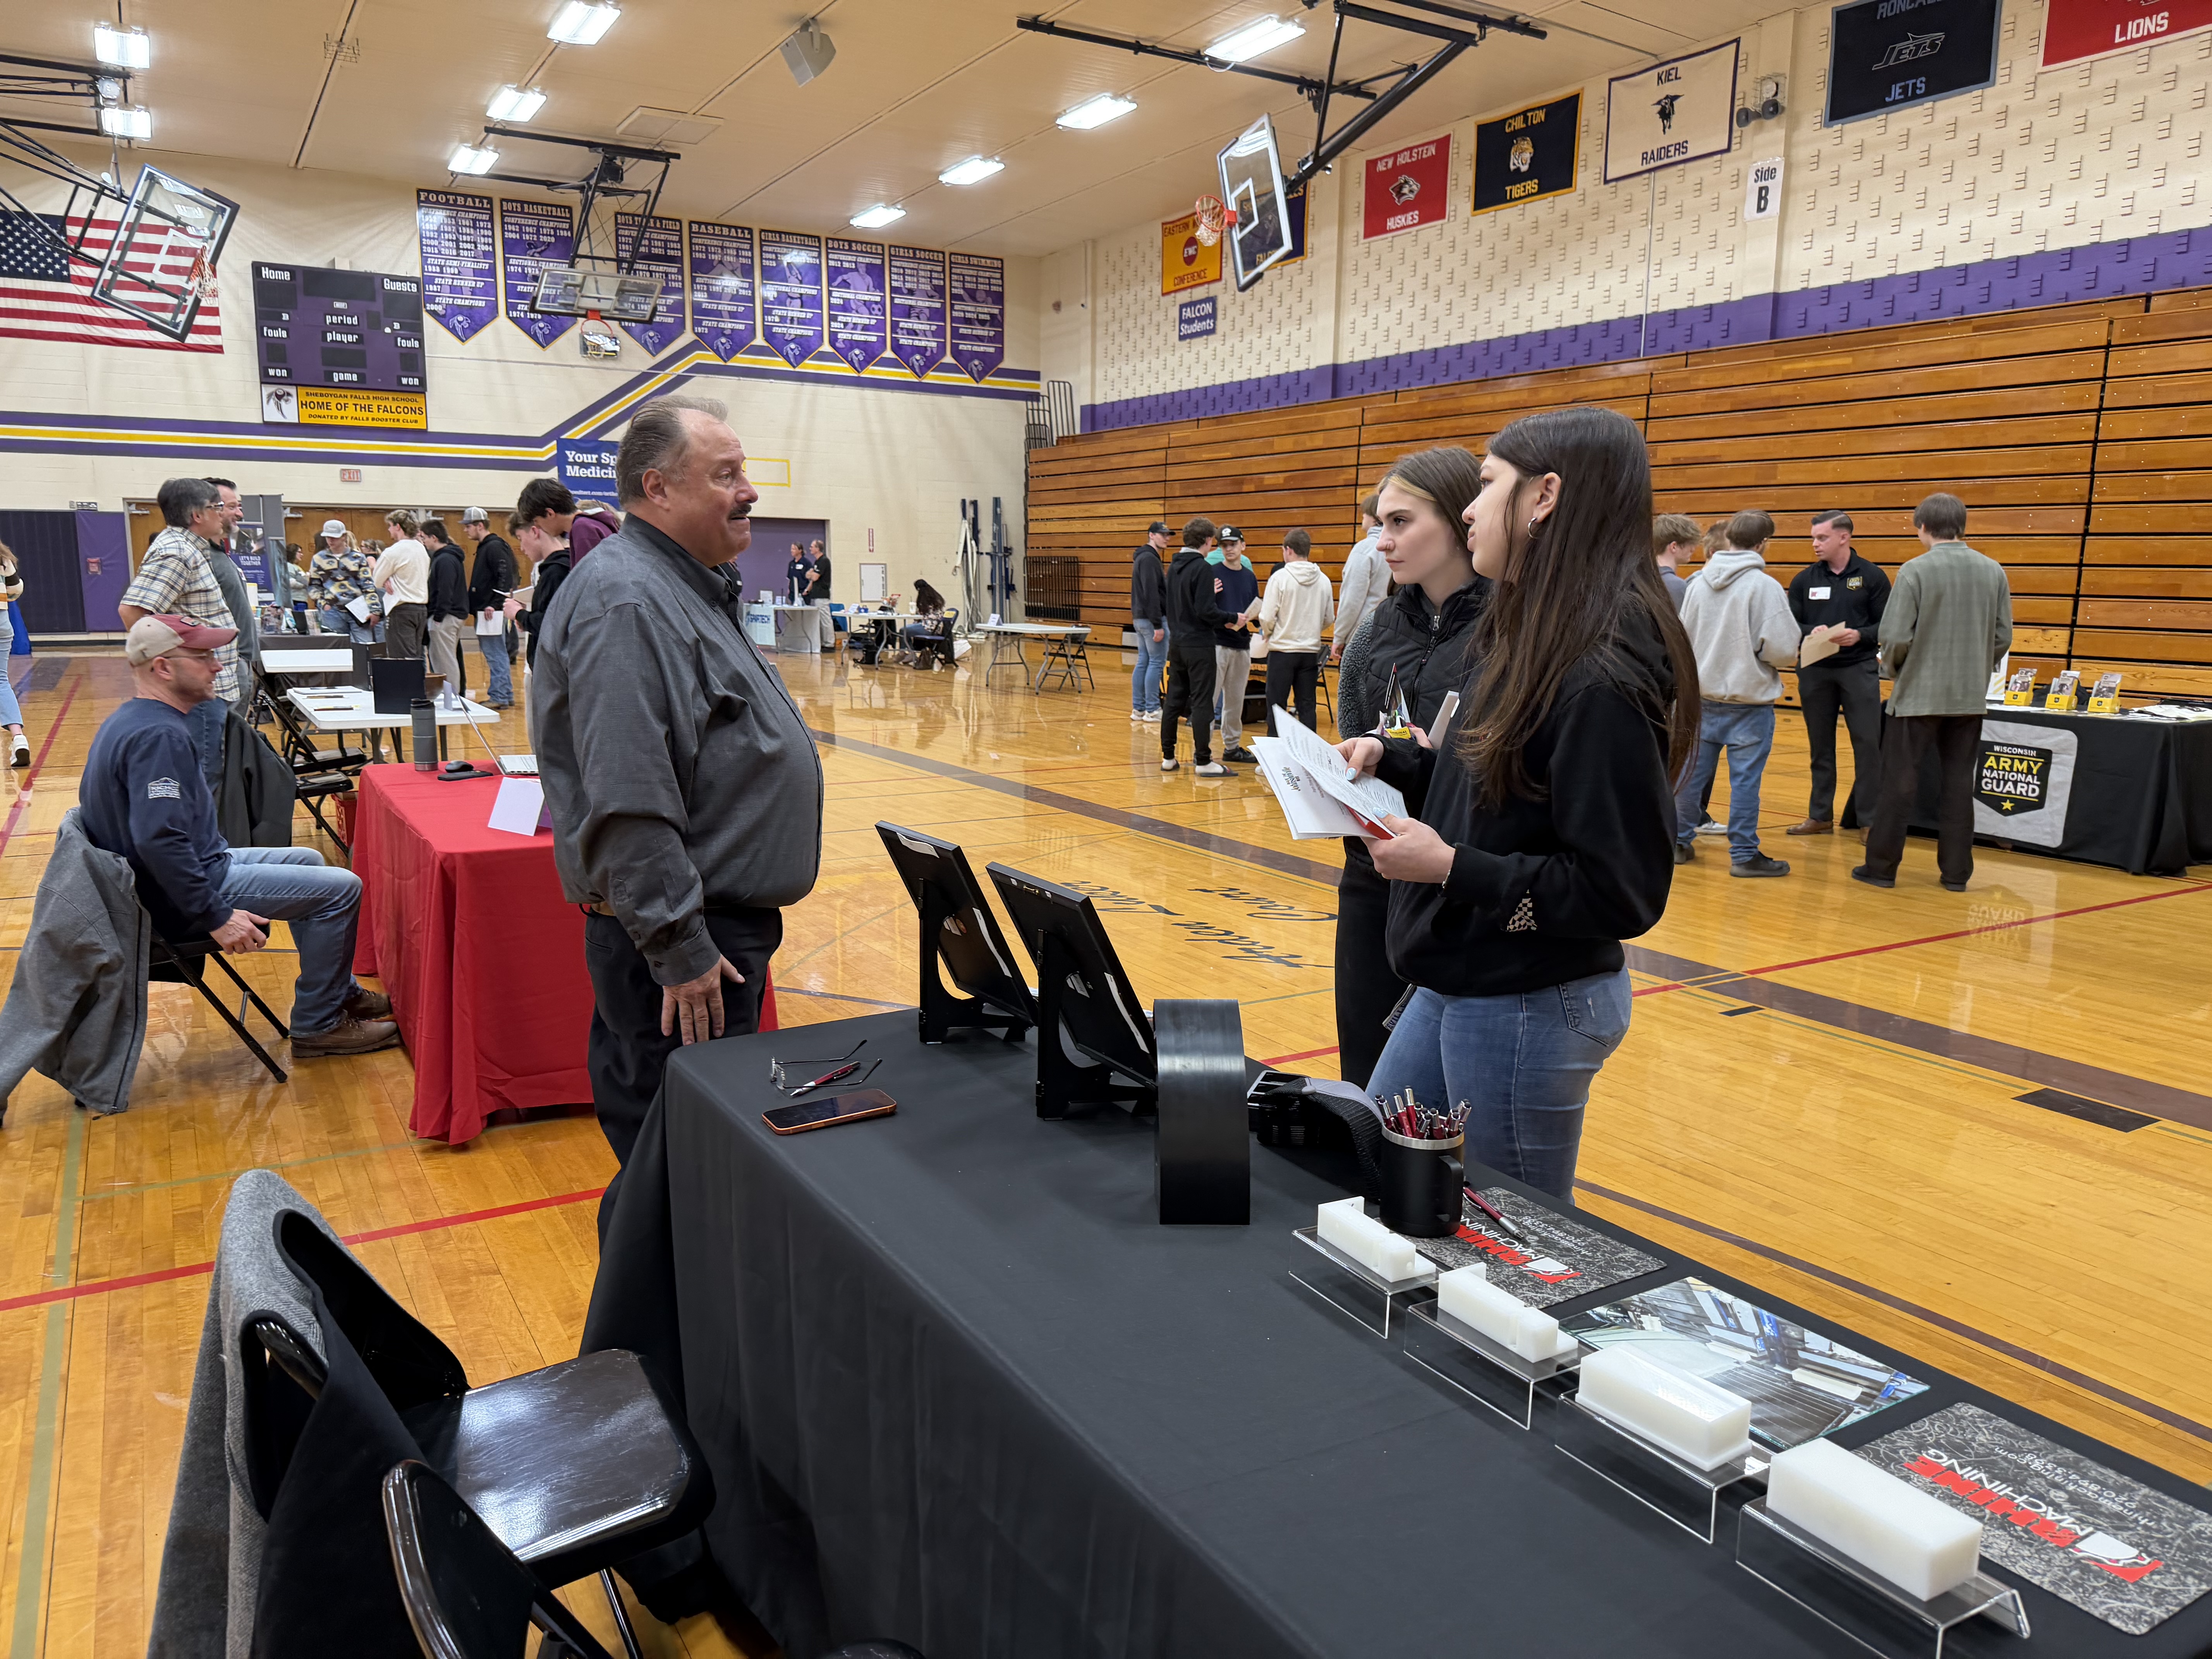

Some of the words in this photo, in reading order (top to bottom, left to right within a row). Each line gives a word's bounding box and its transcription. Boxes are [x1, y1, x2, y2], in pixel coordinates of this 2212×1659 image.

[2114, 11, 2169, 43] LIONS
[1872, 33, 1945, 70] JETS
[1657, 67, 1681, 86] KIEL
[1885, 77, 1925, 102] JETS
[1505, 108, 1546, 133] CHILTON
[1377, 156, 1394, 172] NEW
[1396, 143, 1436, 166] HOLSTEIN
[1641, 140, 1688, 166] RAIDERS
[1754, 166, 1777, 184] Side
[1505, 179, 1538, 200] TIGERS
[419, 192, 490, 208] FOOTBALL
[1756, 186, 1769, 214] B
[458, 212, 489, 220] CHAMPIONS
[502, 201, 521, 211] BOYS
[524, 204, 570, 217] BASKETBALL
[505, 217, 538, 225] CONFERENCE
[539, 220, 569, 228] CHAMPIONS
[617, 215, 632, 224] BOYS
[663, 220, 680, 230] FIELD
[691, 223, 750, 238] BASEBALL
[1164, 221, 1190, 237] EASTERN
[761, 232, 779, 241] GIRLS
[781, 234, 819, 246] BASKETBALL
[828, 240, 849, 250] BOYS
[852, 242, 883, 253] SOCCER
[891, 247, 914, 257] GIRLS
[916, 251, 943, 261] SOCCER
[1184, 245, 1197, 257] EWC
[261, 266, 290, 281] Home
[1174, 268, 1207, 287] CONFERENCE
[384, 278, 417, 292] Guests
[1182, 302, 1213, 319] FALCON
[326, 314, 358, 326] period
[1180, 318, 1214, 336] Students
[263, 326, 287, 338] fouls
[327, 331, 359, 344] player
[397, 337, 419, 348] fouls
[268, 368, 287, 377] won
[333, 372, 357, 382] game
[401, 377, 419, 386] won
[301, 400, 332, 410] HOME
[336, 402, 349, 411] OF
[352, 403, 373, 412] THE
[377, 405, 424, 416] FALCONS
[565, 450, 599, 463] Your
[342, 470, 359, 480] EXIT
[1994, 745, 2036, 756] WISCONSIN
[1984, 756, 2042, 775] ARMY
[1982, 769, 2040, 785] NATIONAL
[1982, 778, 2040, 797] GUARD
[1187, 886, 1339, 921] Court
[1461, 1215, 1544, 1259] MACHININ
[1995, 1446, 2156, 1526] rhinemachining.com
[2025, 1451, 2138, 1508] 920.894.3398
[1923, 1449, 2092, 1535] MACHINING
[1903, 1456, 2080, 1547] RHINE
